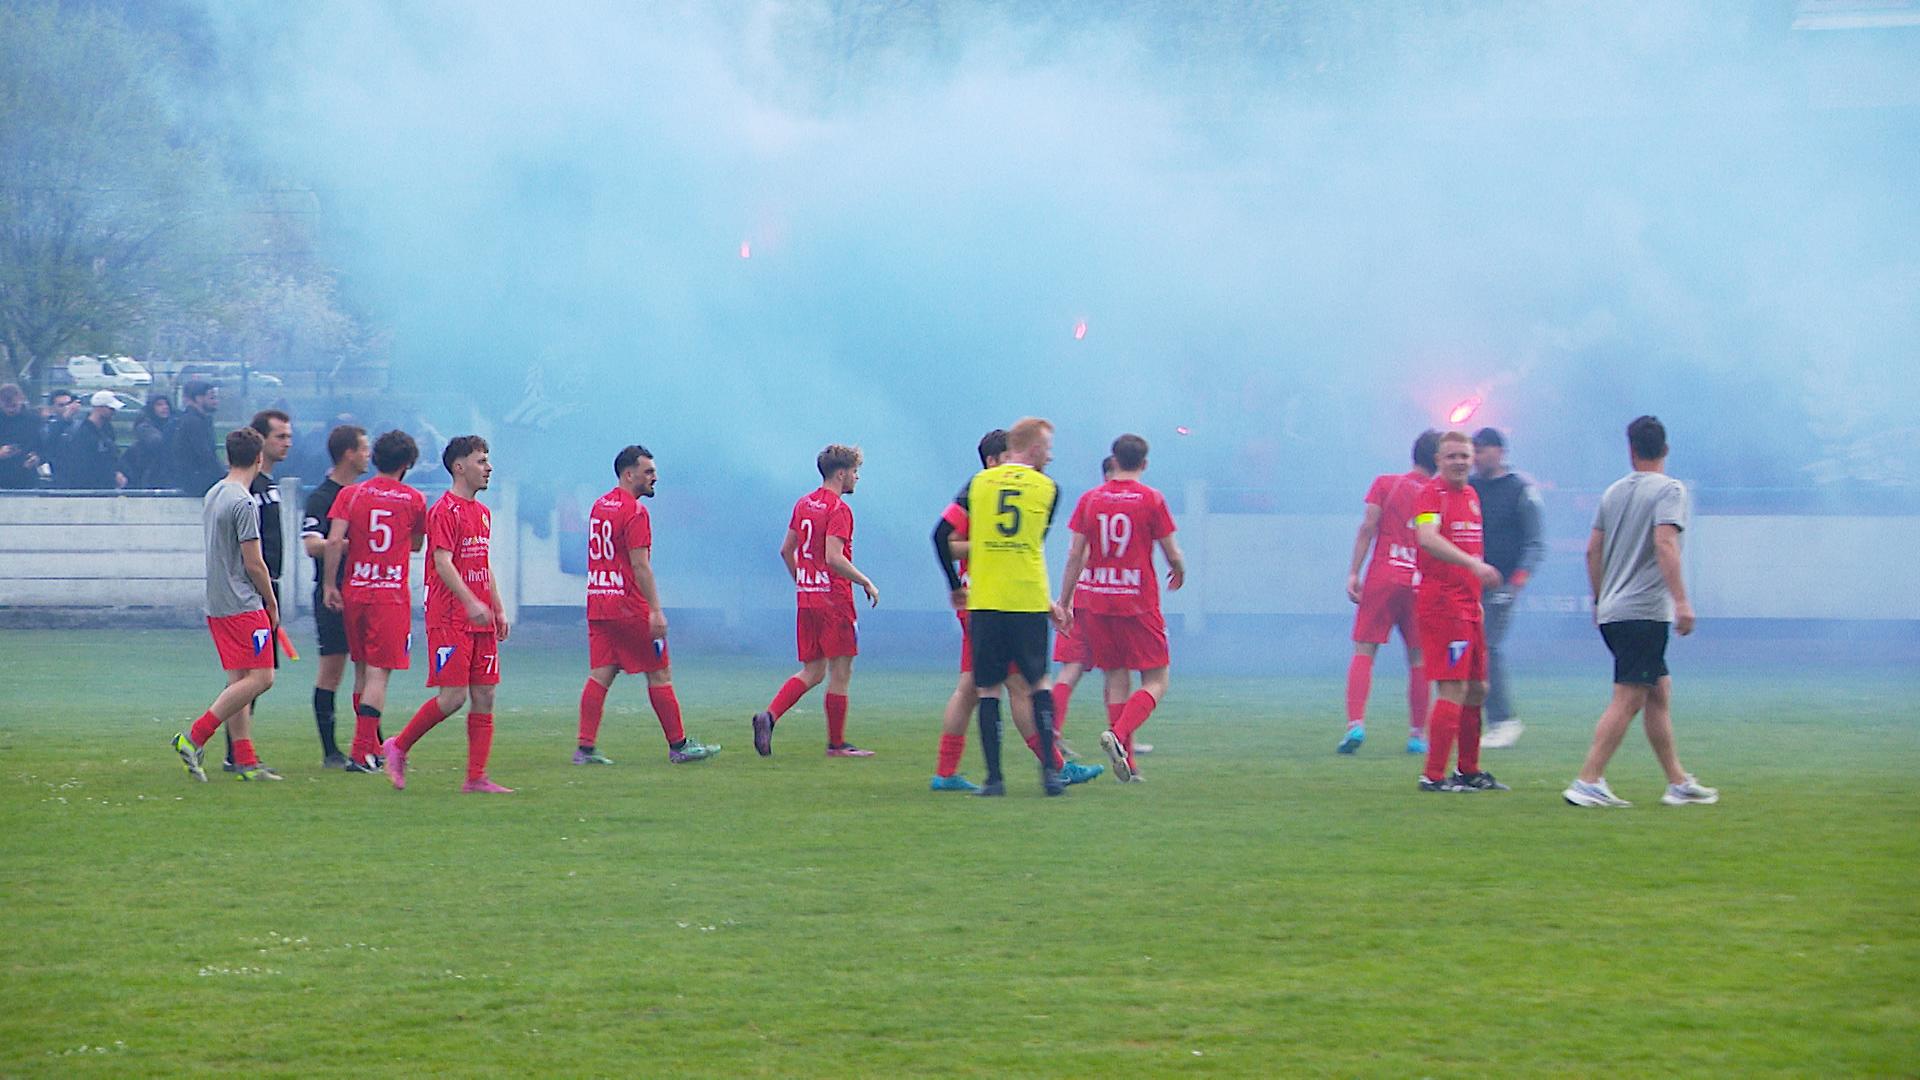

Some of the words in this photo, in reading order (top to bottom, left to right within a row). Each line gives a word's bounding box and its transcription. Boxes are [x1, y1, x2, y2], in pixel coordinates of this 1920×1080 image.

[369, 508, 393, 553] 5
[996, 488, 1022, 537] 5
[589, 517, 615, 561] 58
[800, 518, 814, 559] 2
[1095, 512, 1133, 559] 19
[587, 569, 624, 588] MLN
[795, 567, 832, 585] MLN
